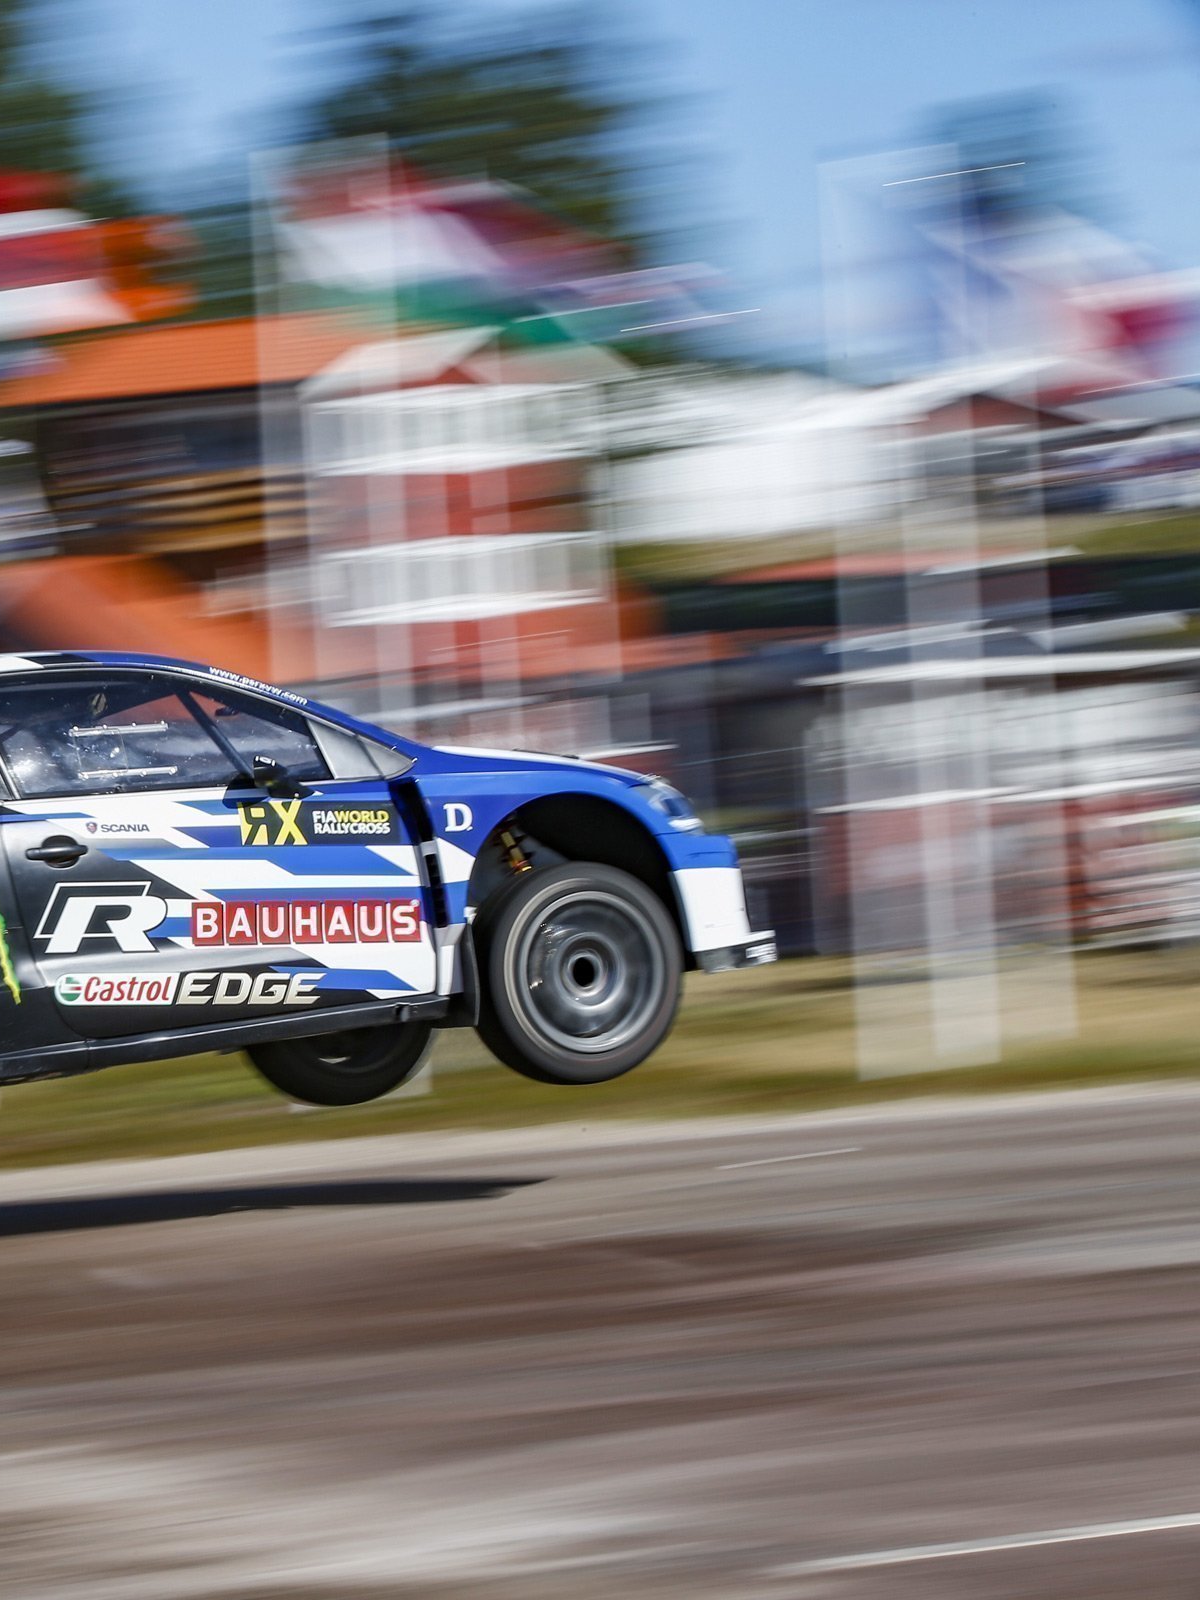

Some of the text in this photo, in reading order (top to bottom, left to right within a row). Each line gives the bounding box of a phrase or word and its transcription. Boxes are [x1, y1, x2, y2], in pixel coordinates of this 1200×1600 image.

[100, 824, 150, 833] SCANIA
[313, 822, 391, 835] RALLYCROSS
[33, 880, 169, 954] R
[195, 902, 418, 940] BAUHAUS
[83, 971, 325, 1006] Castrol EDGE
